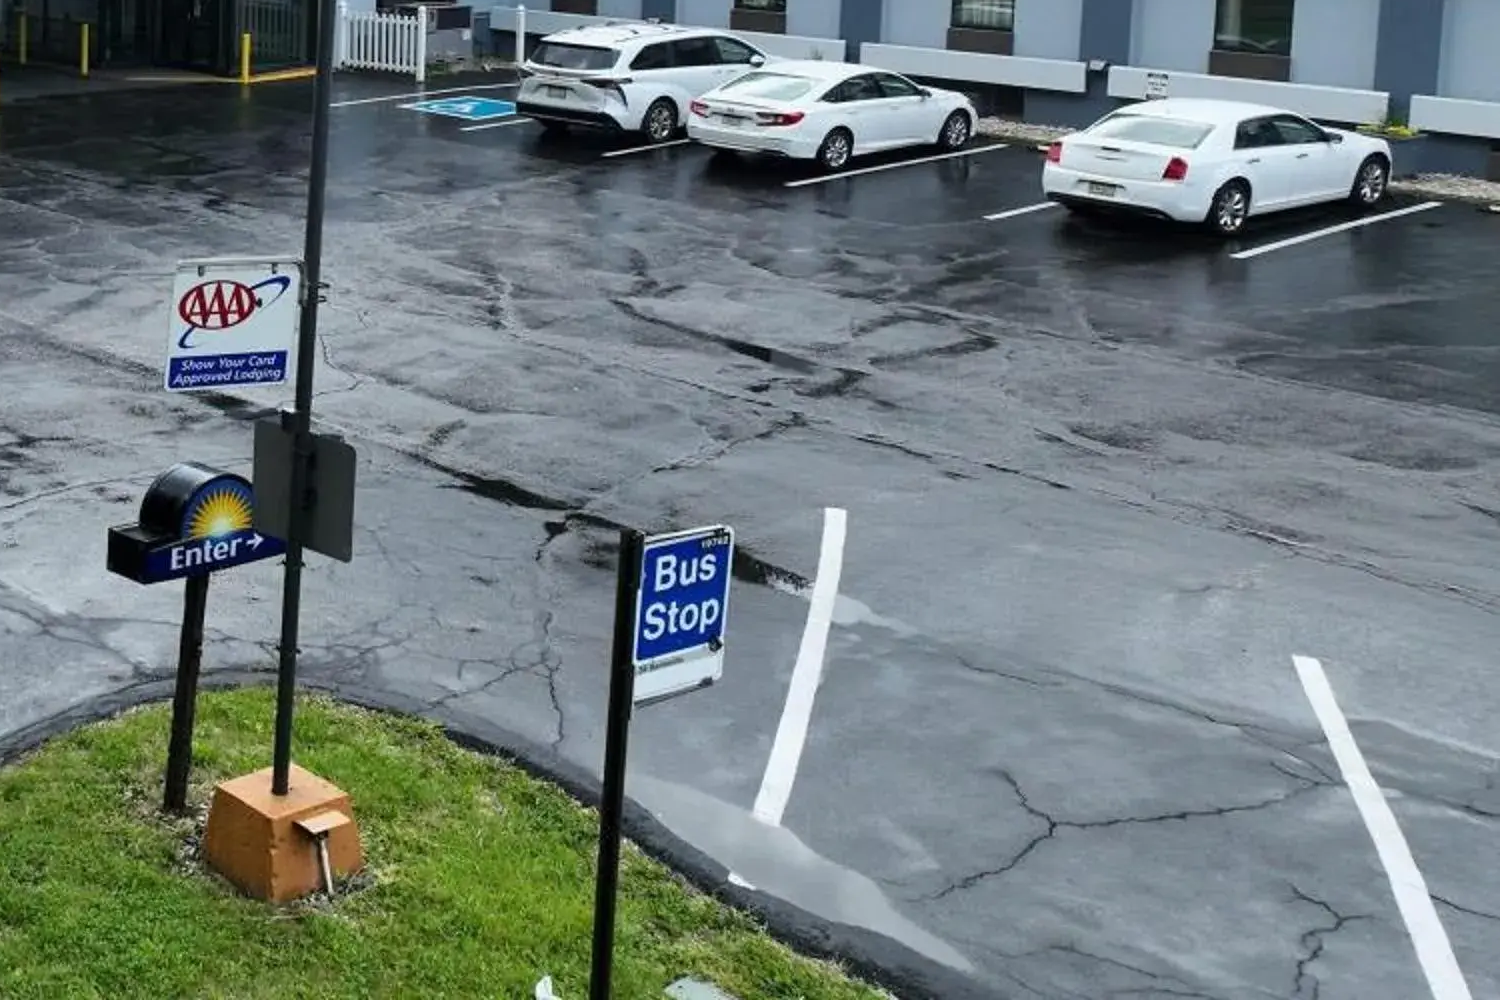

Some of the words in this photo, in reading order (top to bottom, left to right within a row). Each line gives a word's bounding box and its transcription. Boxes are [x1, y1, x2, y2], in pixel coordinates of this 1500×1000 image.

[186, 280, 249, 329] AAA
[172, 369, 233, 386] Approved
[234, 367, 282, 381] Lodging
[181, 358, 215, 371] Show
[219, 356, 246, 368] Your
[248, 354, 277, 367] Card
[170, 537, 242, 571] Enter
[654, 553, 717, 592] Bus
[643, 598, 720, 640] Stop
